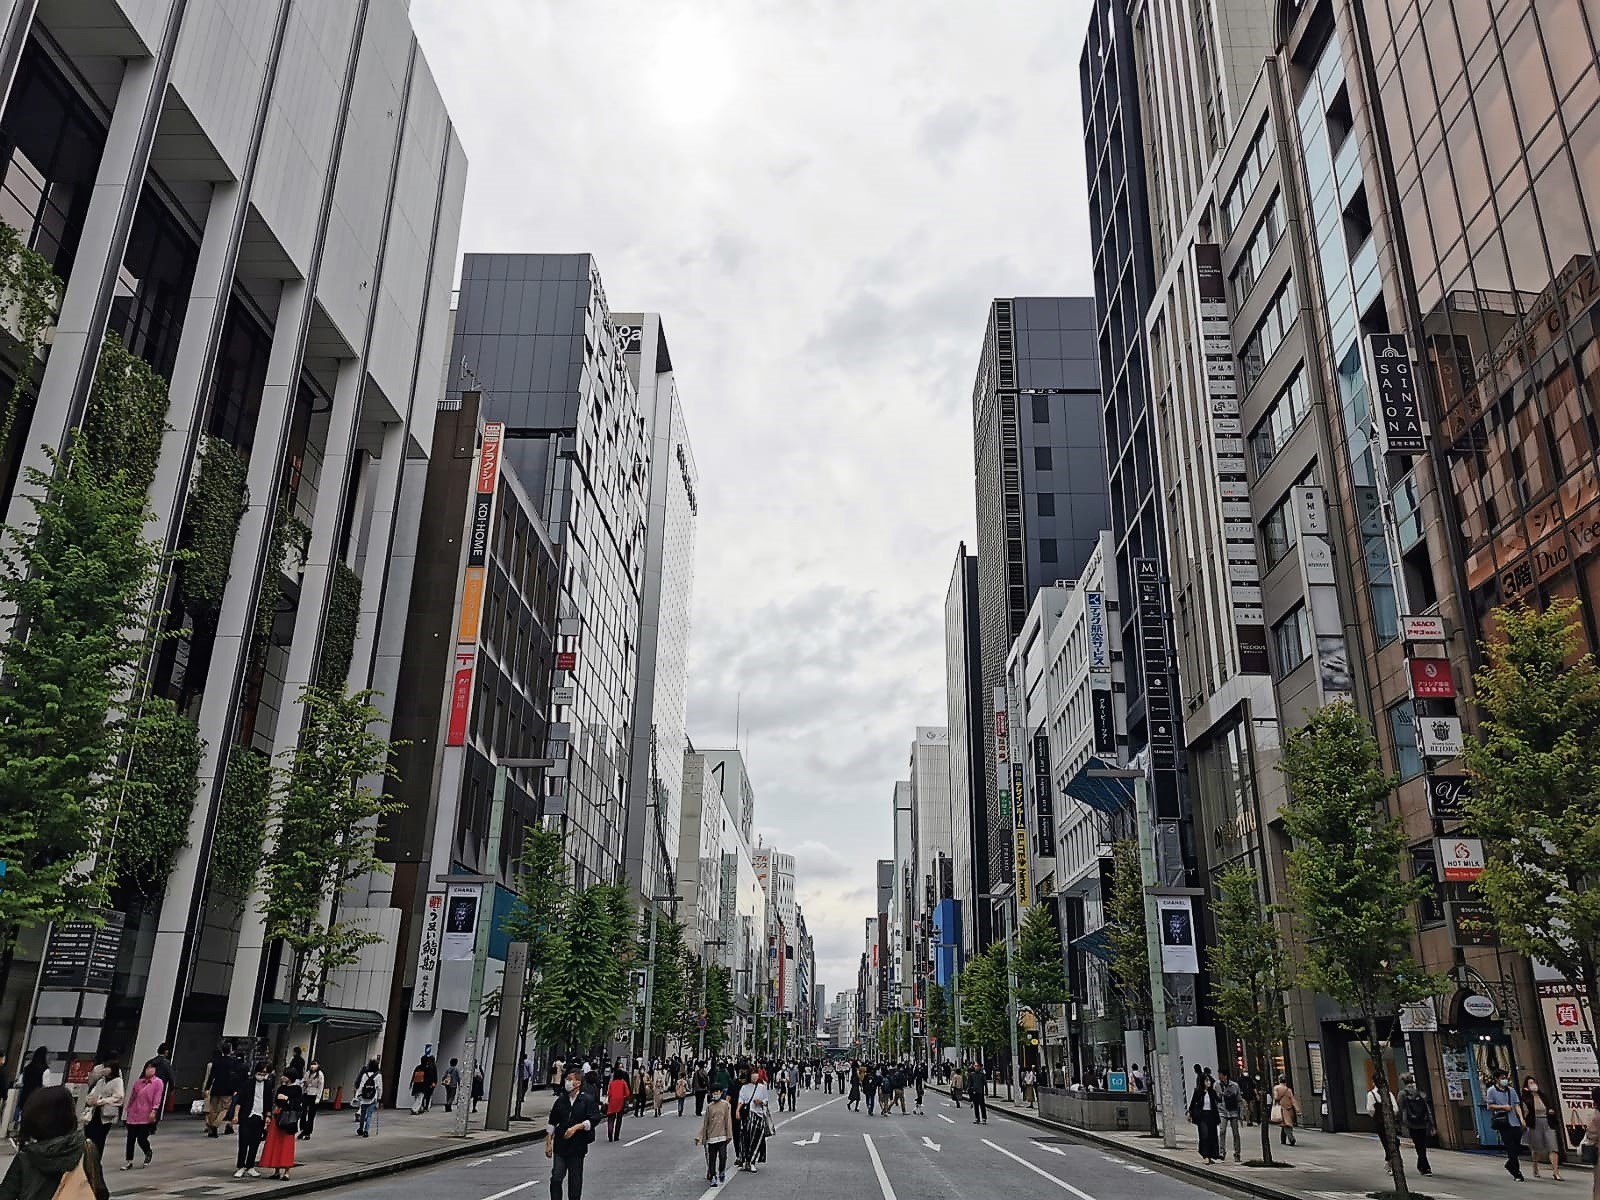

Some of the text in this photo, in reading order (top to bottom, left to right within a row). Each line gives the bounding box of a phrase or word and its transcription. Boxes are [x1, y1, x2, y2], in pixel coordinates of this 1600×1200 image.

[1380, 363, 1400, 432] SALON
[1396, 363, 1417, 432] GINZA
[1502, 560, 1533, 599] 3階
[1017, 832, 1026, 857] ELITE
[1558, 1006, 1577, 1023] 質
